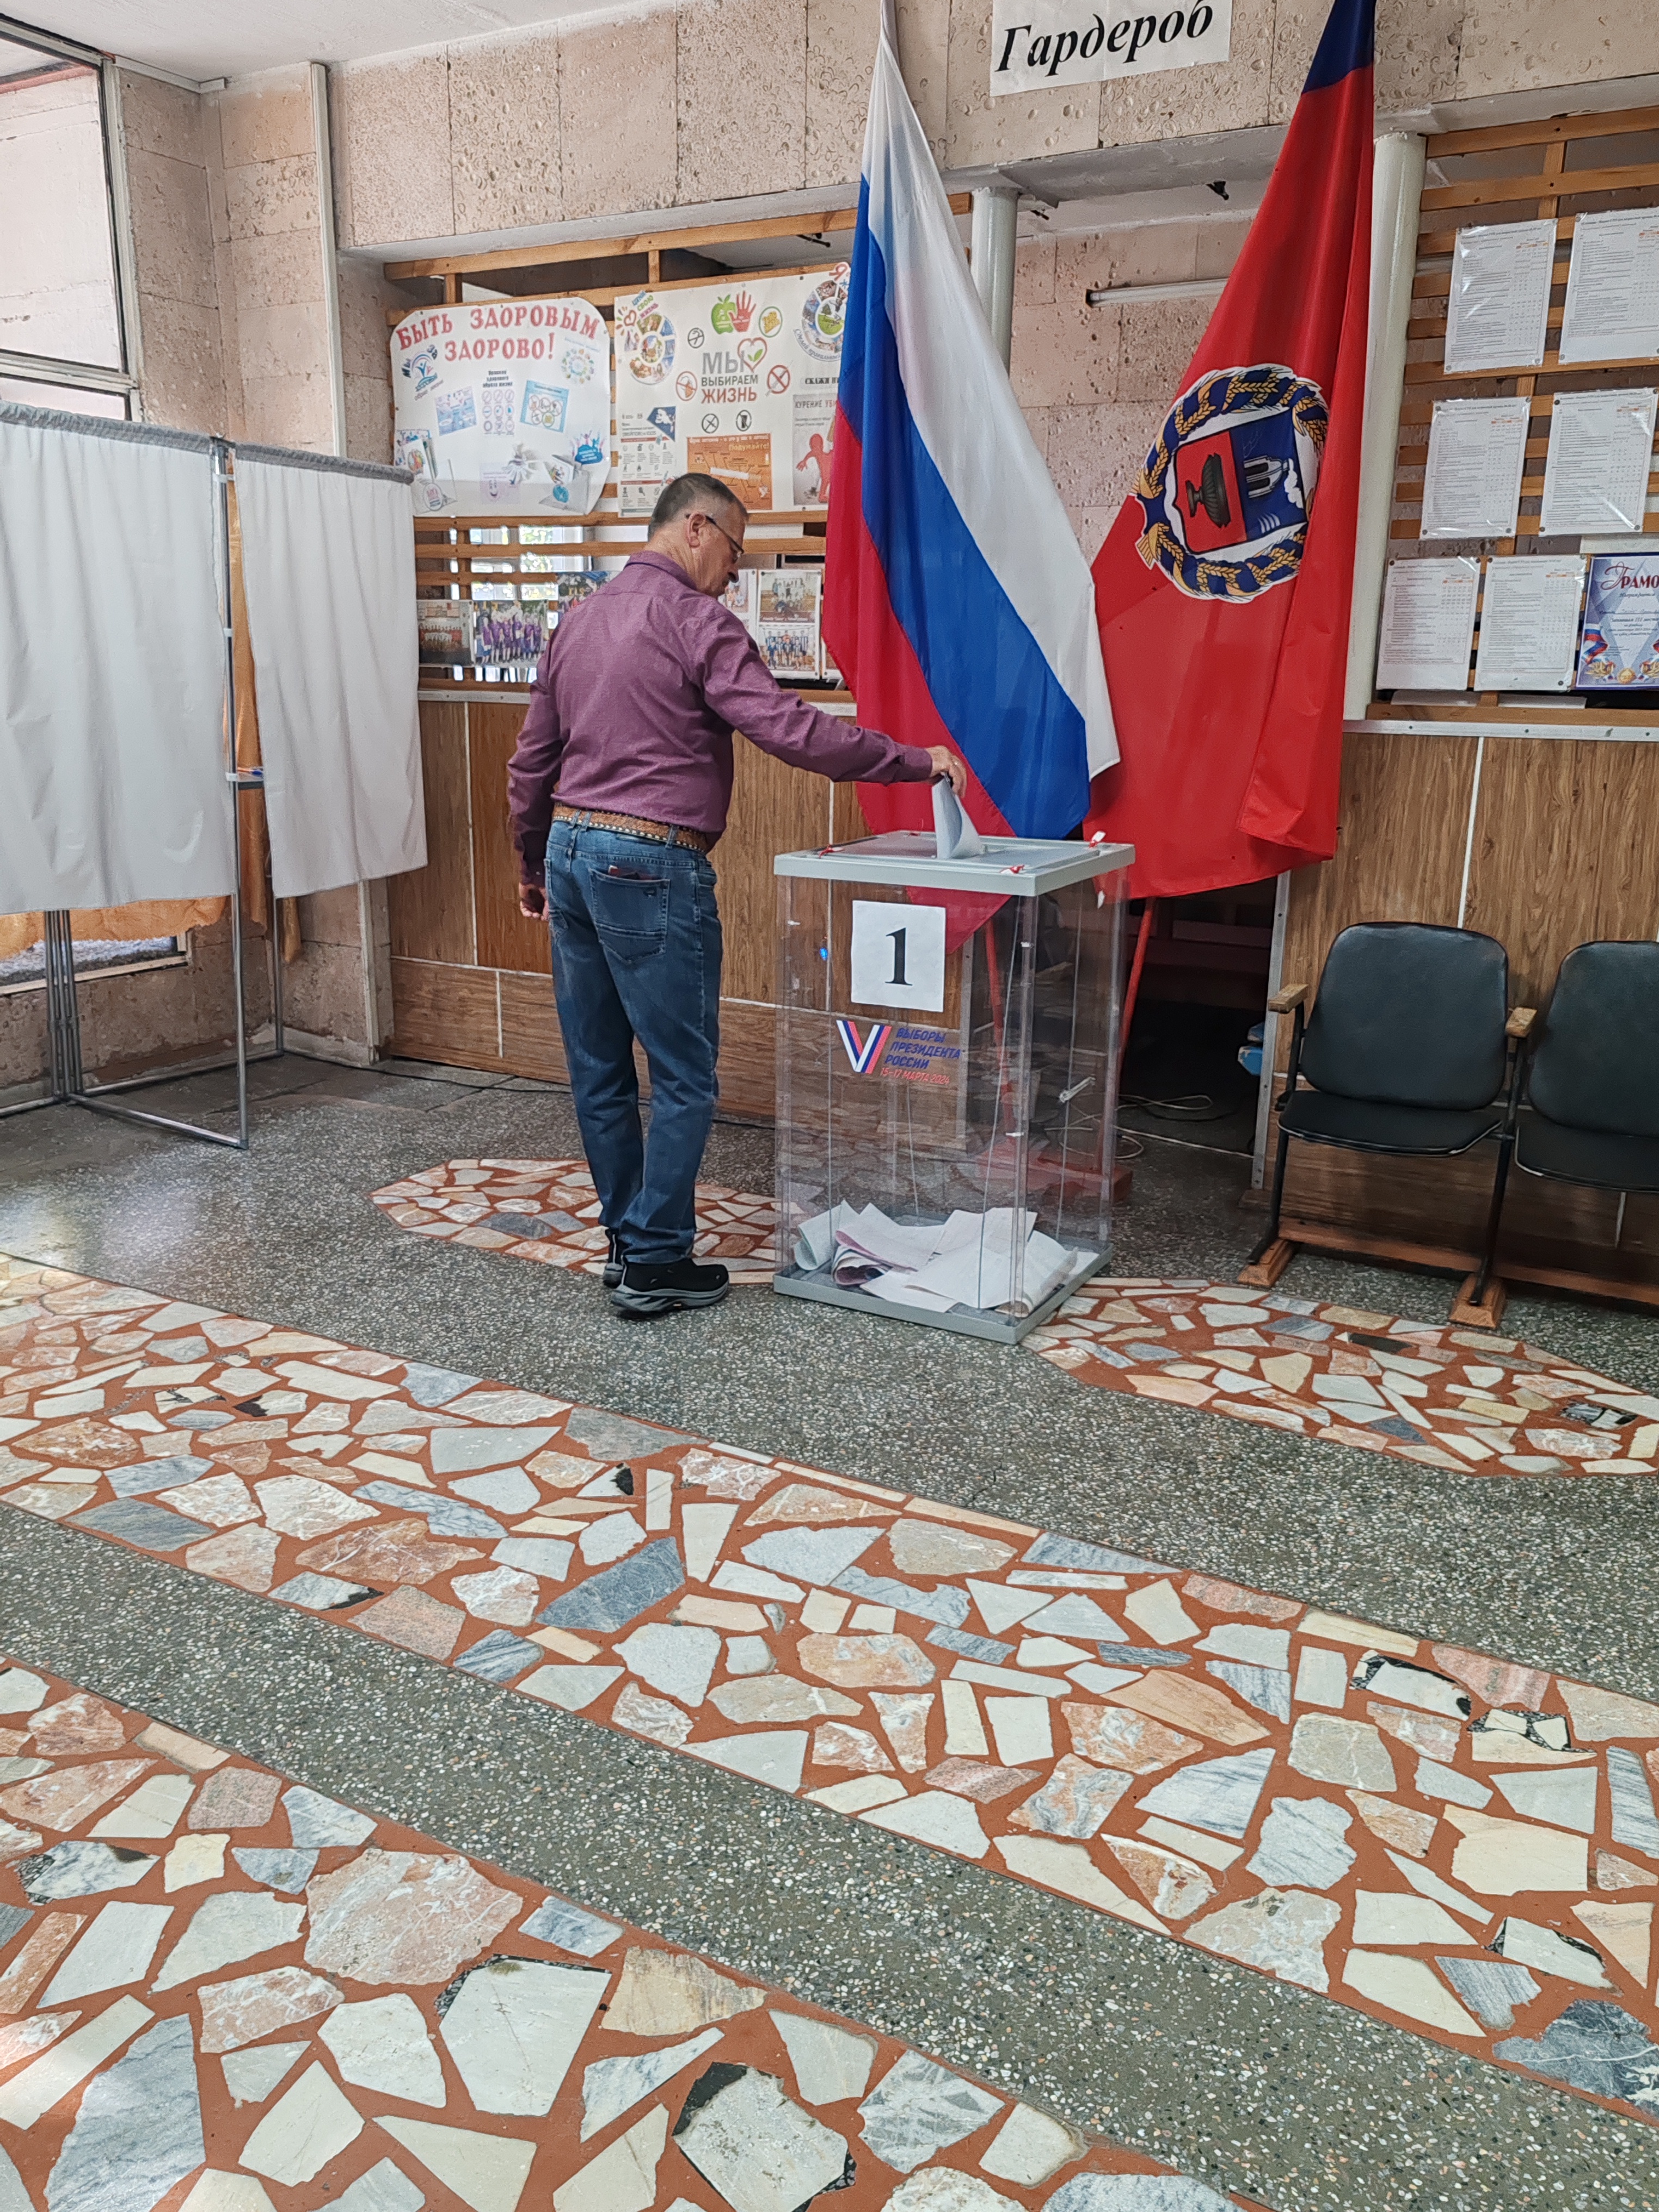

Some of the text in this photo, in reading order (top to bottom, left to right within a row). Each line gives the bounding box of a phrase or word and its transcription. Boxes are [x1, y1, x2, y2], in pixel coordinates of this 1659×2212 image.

[994, 0, 1213, 77] Гардероб
[396, 305, 600, 351] БЫТЬ ЗДОРОВЫМ
[445, 333, 555, 361] ЗДОРОВО!
[702, 351, 745, 374] МЫ
[701, 374, 758, 386] ВЫБИРАЕМ
[701, 386, 757, 404] ЖИЗНЬ
[885, 927, 913, 986] 1
[896, 1028, 947, 1043] ВЫБОРЫ
[889, 1041, 961, 1059] ПРЕЗИДЕНТА
[884, 1054, 930, 1069] РОССИИ
[902, 1070, 929, 1082] МАРТА
[930, 1074, 950, 1084] 2024
